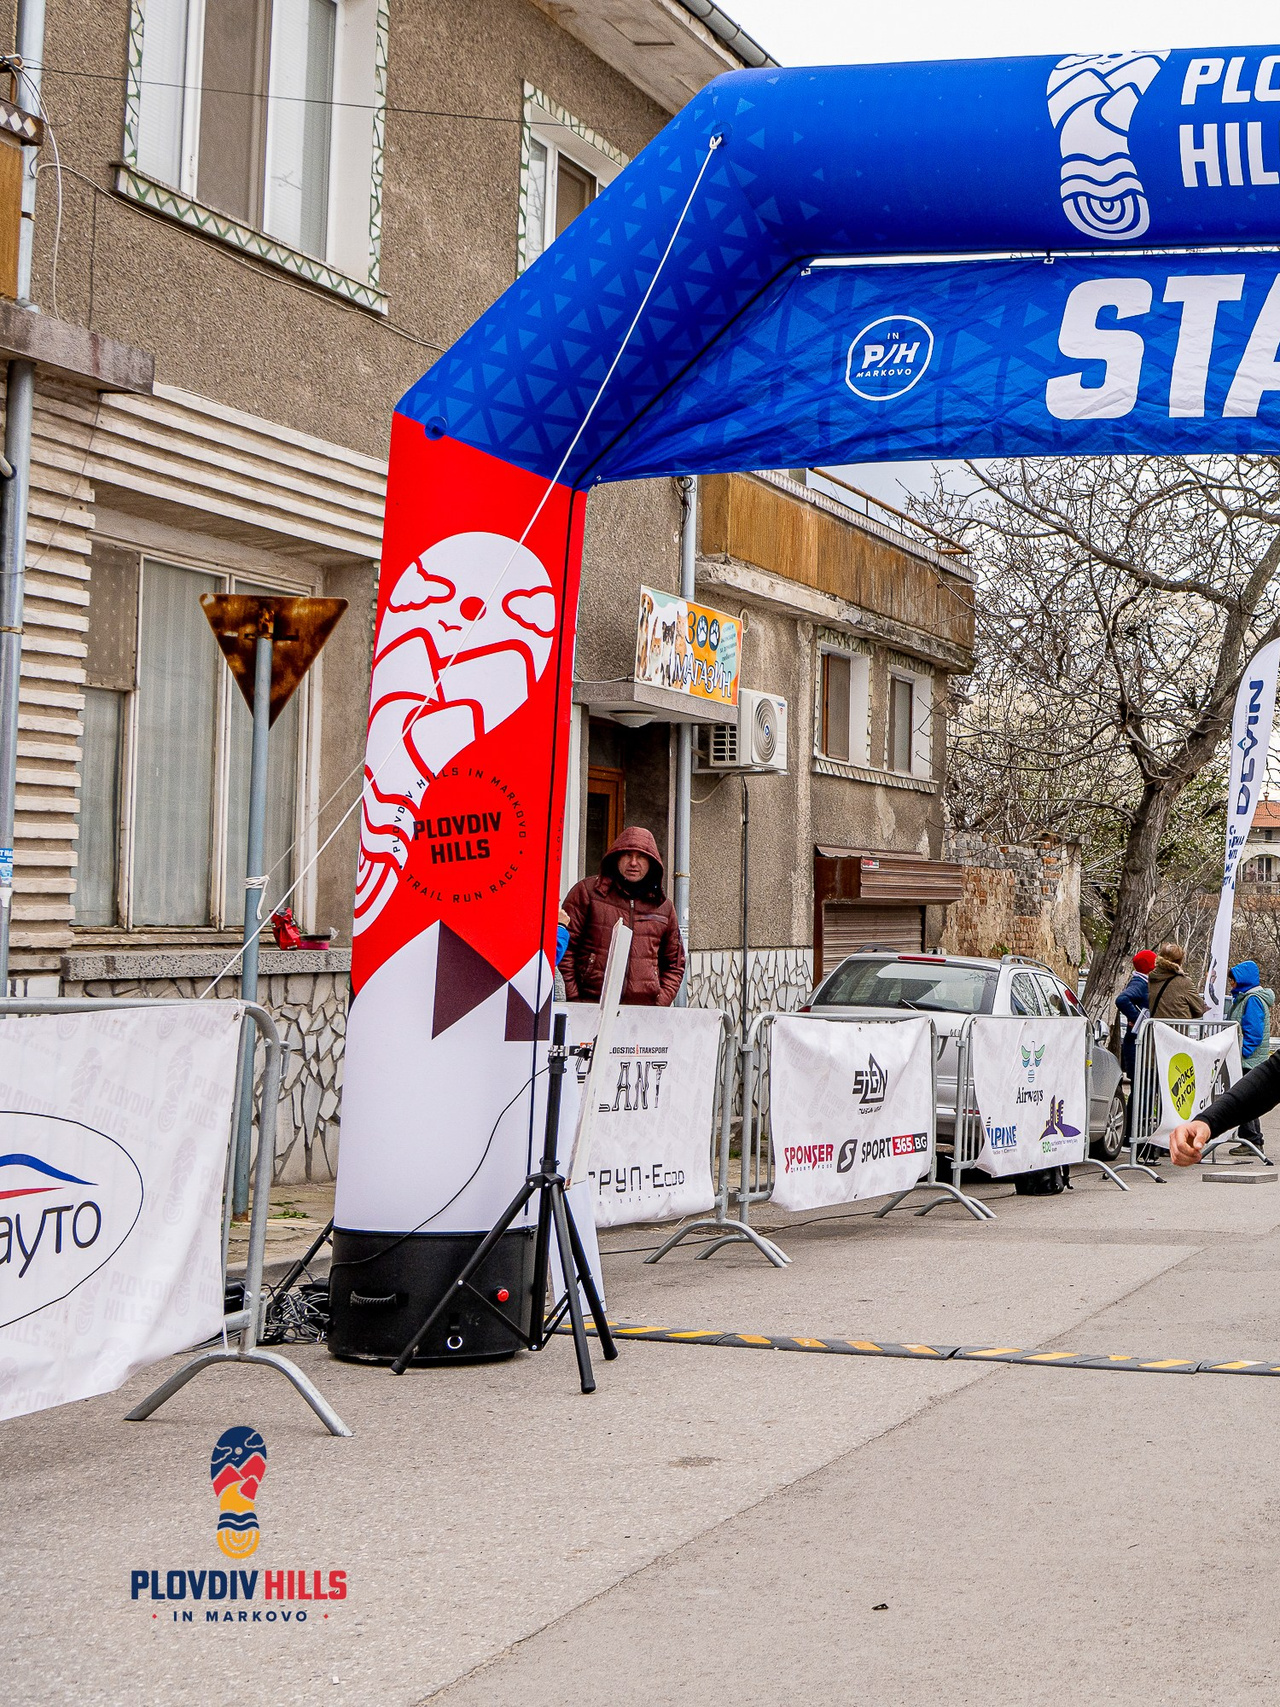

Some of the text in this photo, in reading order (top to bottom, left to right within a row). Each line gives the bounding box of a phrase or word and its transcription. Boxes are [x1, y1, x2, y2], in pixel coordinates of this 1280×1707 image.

[887, 331, 900, 341] IN
[861, 342, 920, 370] P/H
[855, 367, 912, 378] MARKOVO
[674, 653, 731, 698] МАГАЗИН
[392, 790, 413, 853] PLOVDIV
[417, 767, 459, 789] HILLS
[468, 768, 484, 779] IN
[491, 777, 526, 839] MARKOVO
[412, 811, 502, 841] PLOVDIV
[430, 838, 491, 864] HILLS
[406, 863, 518, 903] TRAIL RUN RACE
[639, 1046, 669, 1054] TRANSPORT
[1177, 1065, 1195, 1088] POKE
[1016, 1086, 1044, 1106] Airways
[784, 1143, 834, 1174] SPONSER
